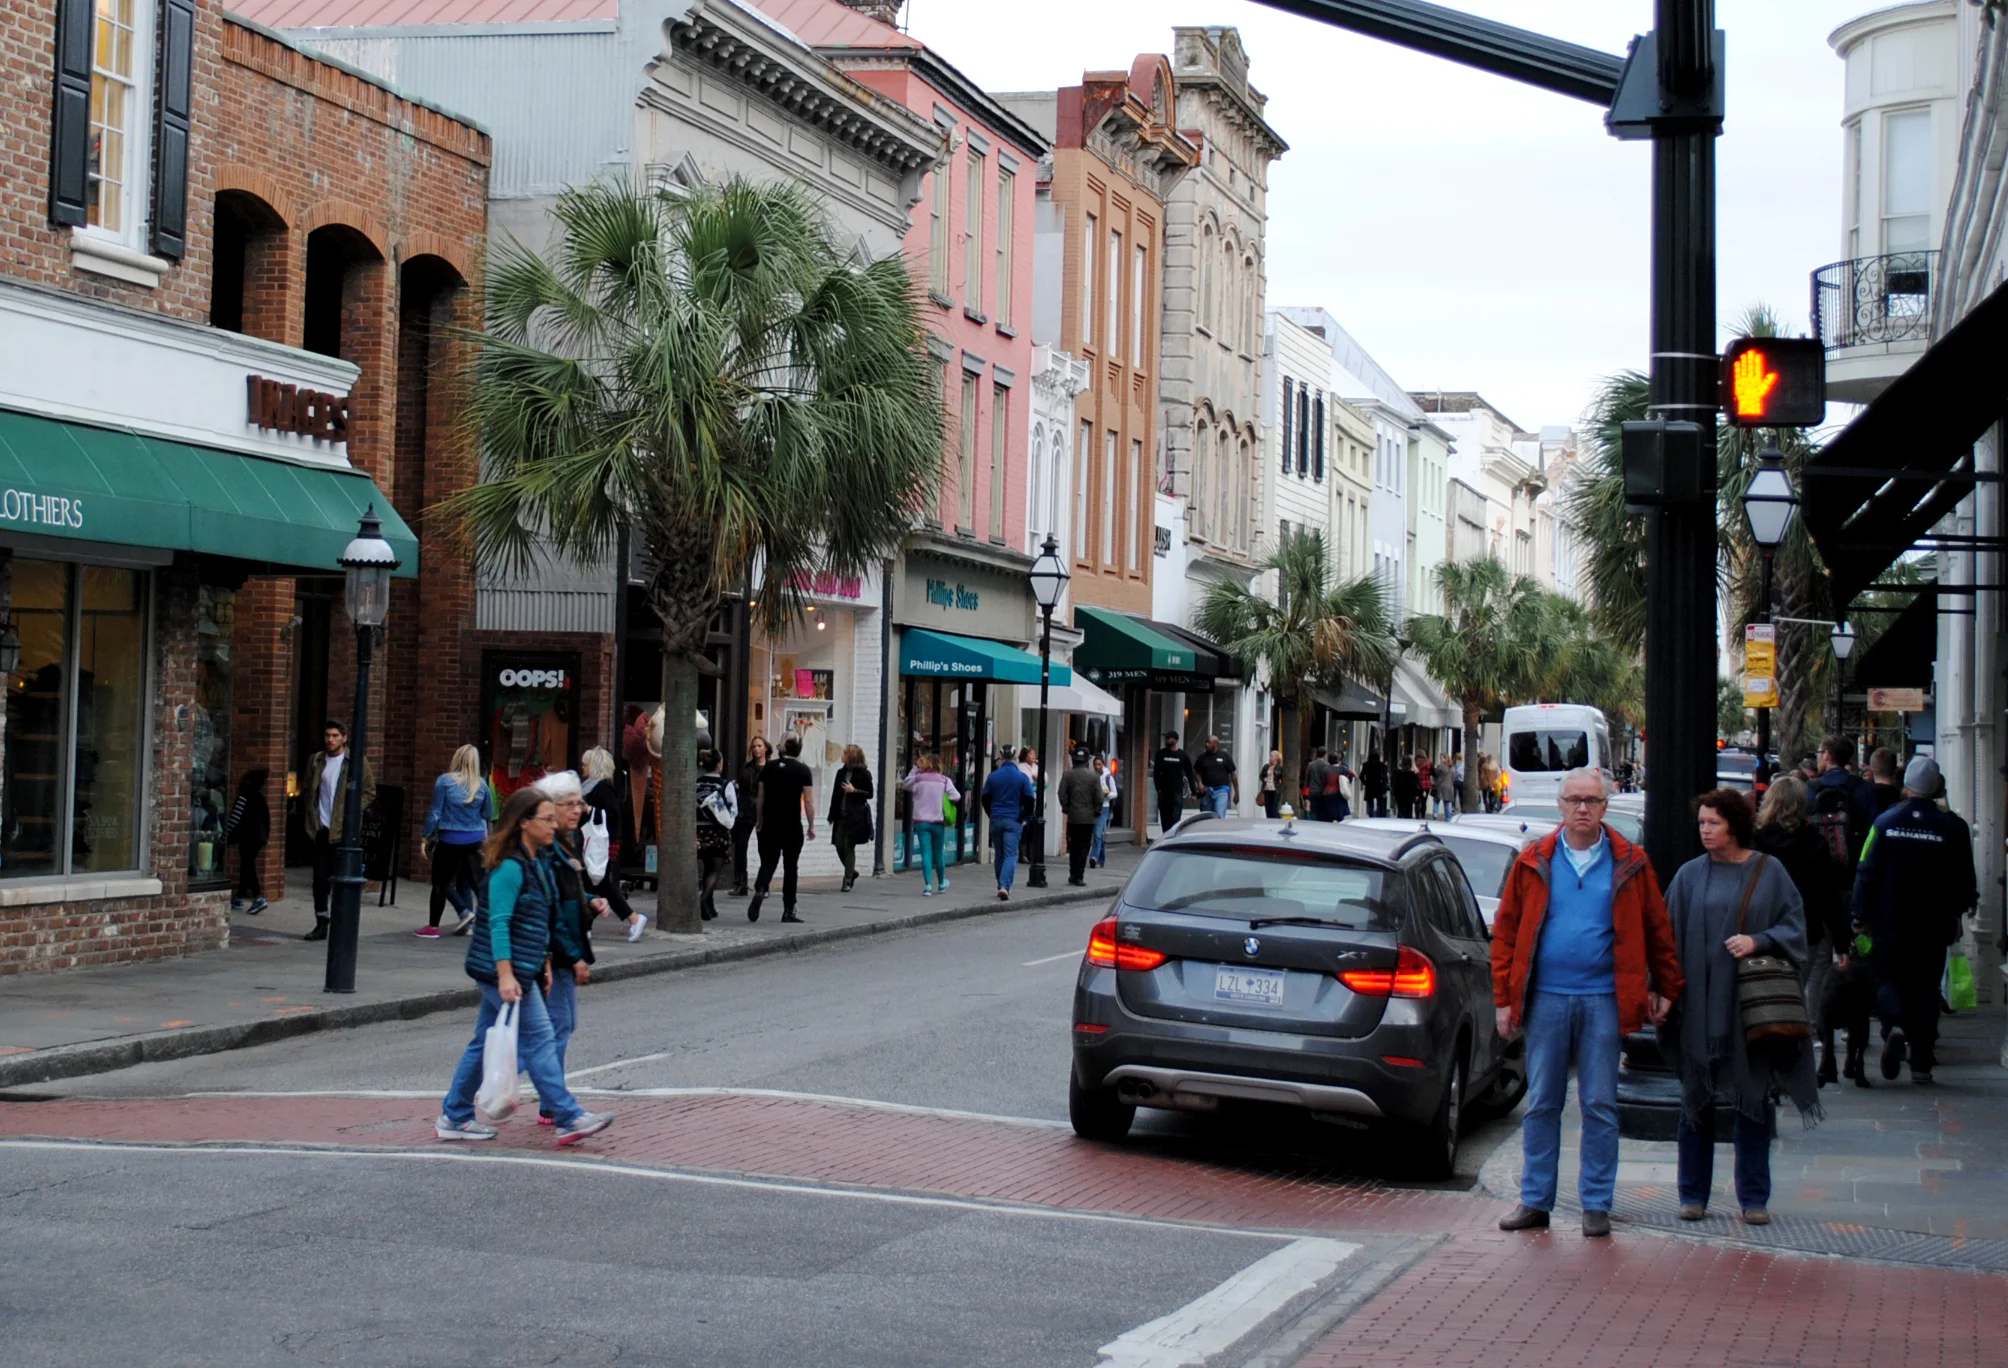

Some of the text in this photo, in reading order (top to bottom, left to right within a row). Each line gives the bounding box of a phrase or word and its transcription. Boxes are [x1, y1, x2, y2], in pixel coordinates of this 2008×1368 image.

[0, 489, 83, 529] OTHIERS
[910, 660, 983, 673] Phillip's Shoes
[499, 668, 564, 688] OOPS!
[1108, 670, 1147, 678] 319 MEN
[1169, 675, 1191, 684] MEN
[1886, 829, 1943, 842] SEAHAWKS
[1219, 974, 1278, 996] LZL 334
